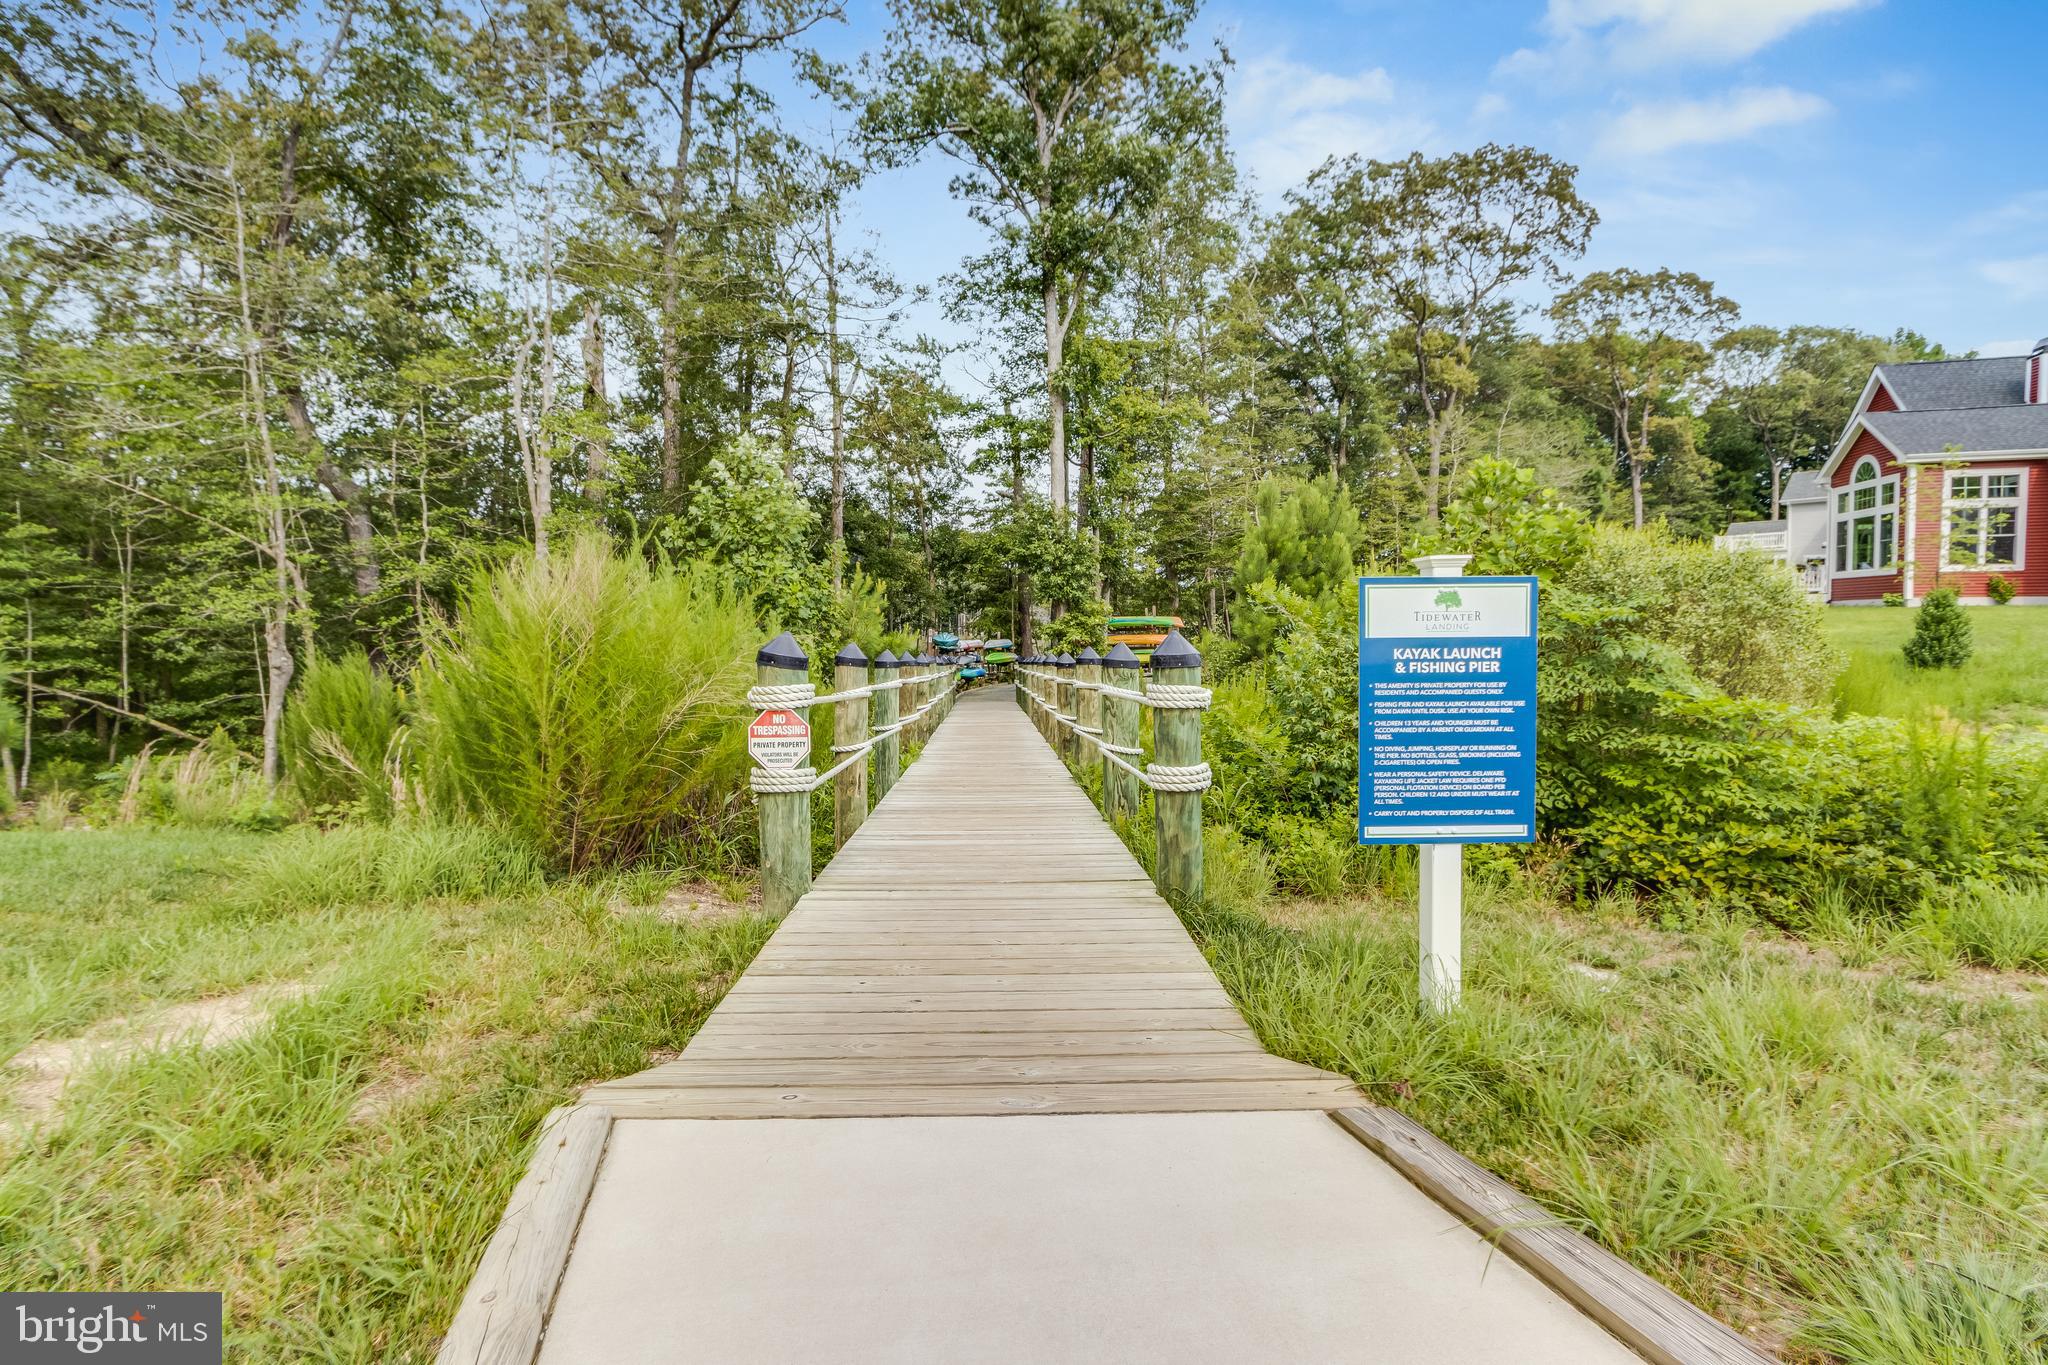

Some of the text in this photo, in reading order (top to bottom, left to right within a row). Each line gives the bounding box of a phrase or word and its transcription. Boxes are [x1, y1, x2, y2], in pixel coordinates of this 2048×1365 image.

[1414, 611, 1480, 622] TIDEWATER
[1394, 647, 1502, 660] KAYAK LAUNCH
[1394, 662, 1500, 674] & FISHING PIER
[772, 714, 786, 724] NO
[753, 725, 805, 735] TRESPASSING
